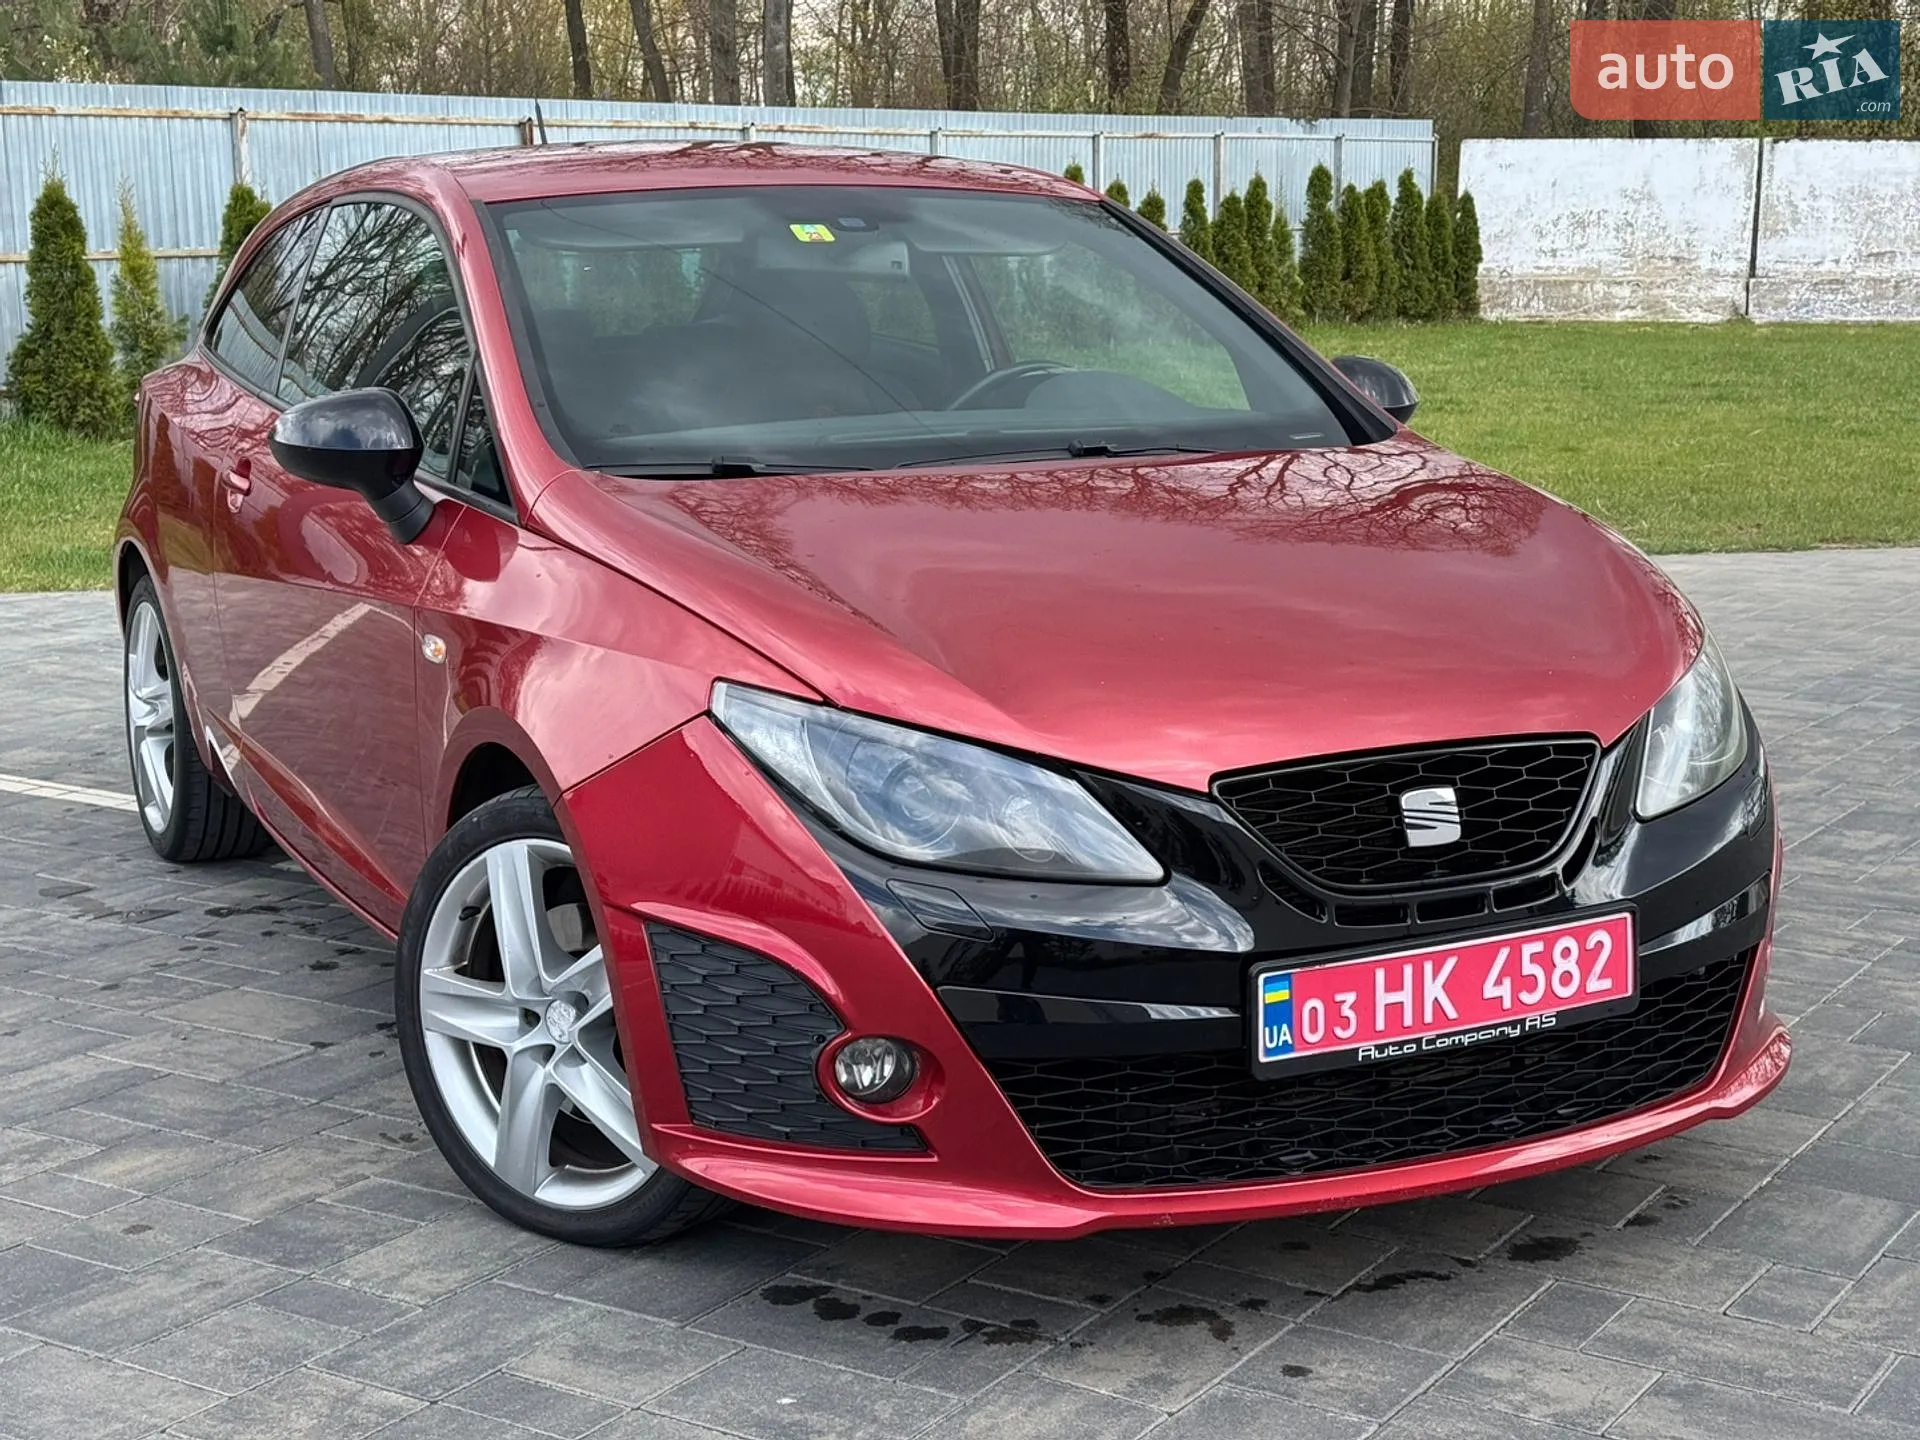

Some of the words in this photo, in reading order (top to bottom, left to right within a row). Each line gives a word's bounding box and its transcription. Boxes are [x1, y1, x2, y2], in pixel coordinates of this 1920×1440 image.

[1301, 991, 1357, 1044] 03
[1375, 955, 1459, 1032] HK
[1483, 929, 1613, 1011] 4582
[1265, 1024, 1293, 1049] UA
[1358, 1043, 1416, 1062] Auto
[1422, 1023, 1520, 1052] Company
[1525, 1012, 1557, 1030] AS
